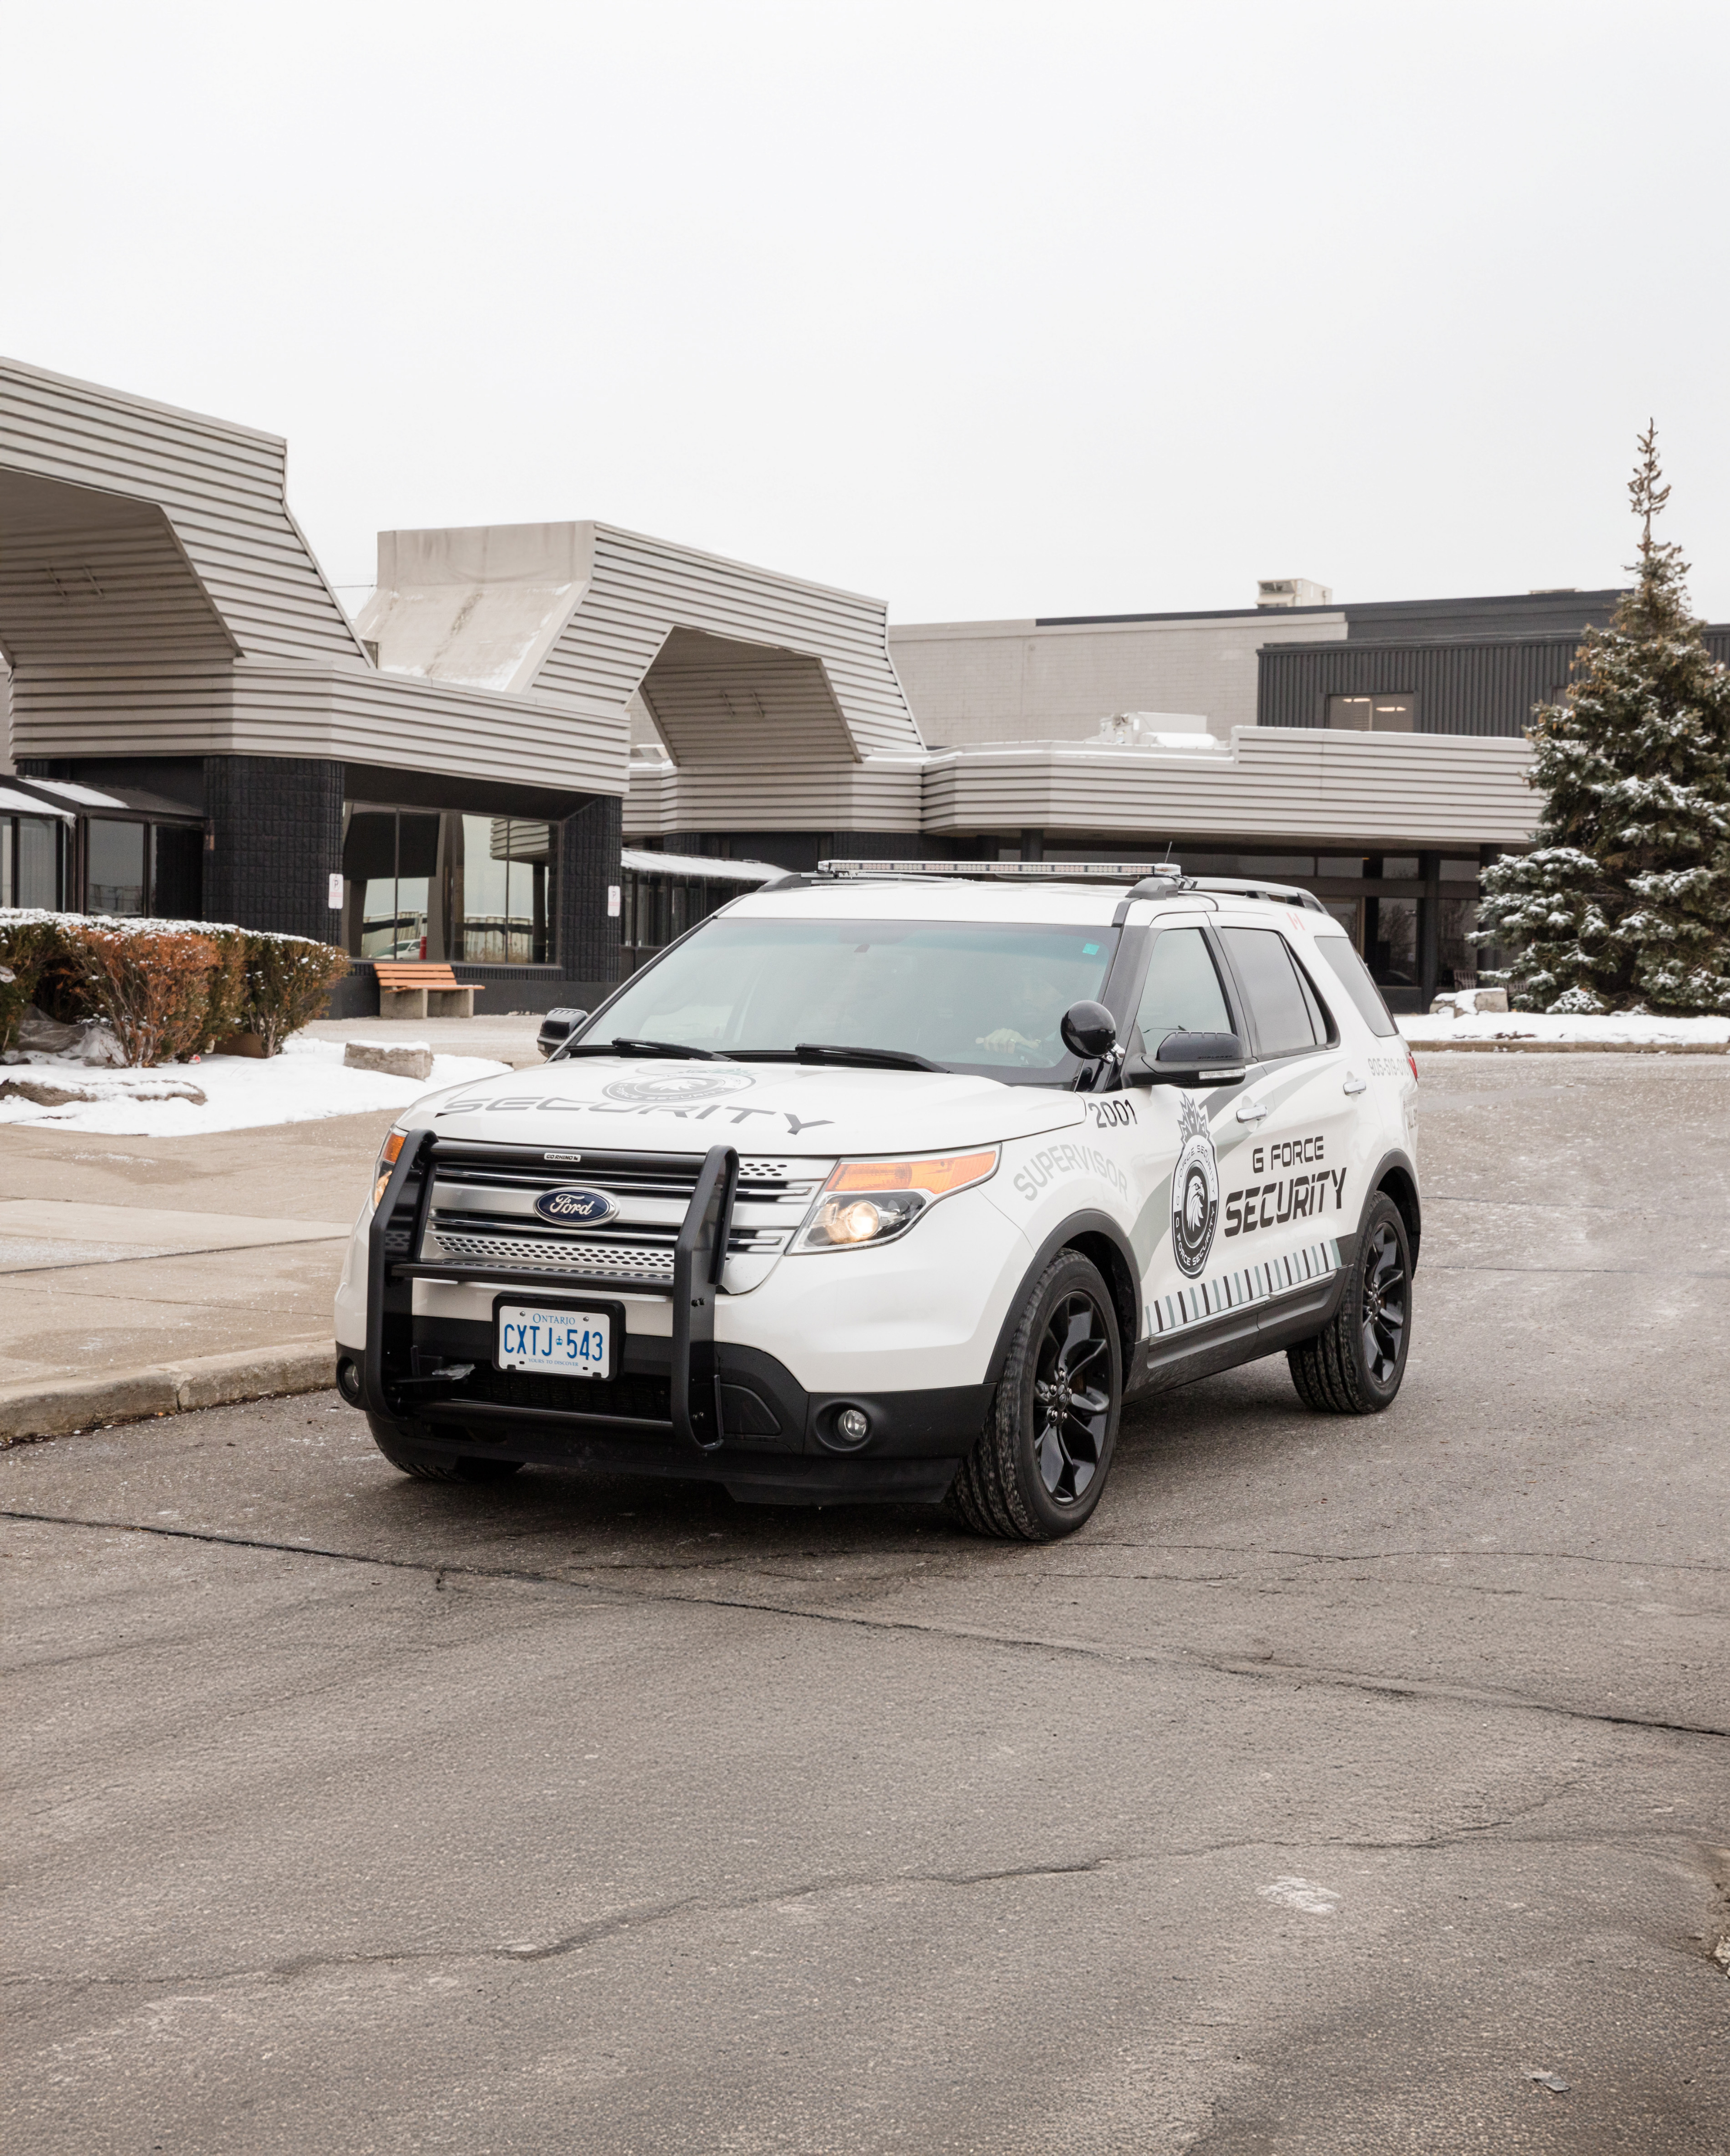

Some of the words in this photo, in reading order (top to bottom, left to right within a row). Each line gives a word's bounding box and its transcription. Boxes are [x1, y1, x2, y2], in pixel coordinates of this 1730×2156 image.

[616, 1087, 643, 1099] FORCE
[645, 1088, 725, 1100] SECURITY
[434, 1096, 835, 1135] SECURITY
[1087, 1099, 1138, 1129] 2001
[1013, 1144, 1128, 1202] SUPERVISOR
[1177, 1147, 1195, 1189] FORCE
[1197, 1145, 1215, 1195] SECURITY
[1252, 1147, 1264, 1174] G
[1271, 1135, 1324, 1170] FORCE
[549, 1193, 595, 1215] Ford
[1224, 1166, 1347, 1238] SECURITY
[1177, 1232, 1191, 1266] FORCE
[1192, 1205, 1215, 1266] SECURITY
[533, 1313, 575, 1326] ONTARIO
[504, 1324, 553, 1356] CXTJ
[566, 1329, 603, 1361] 543
